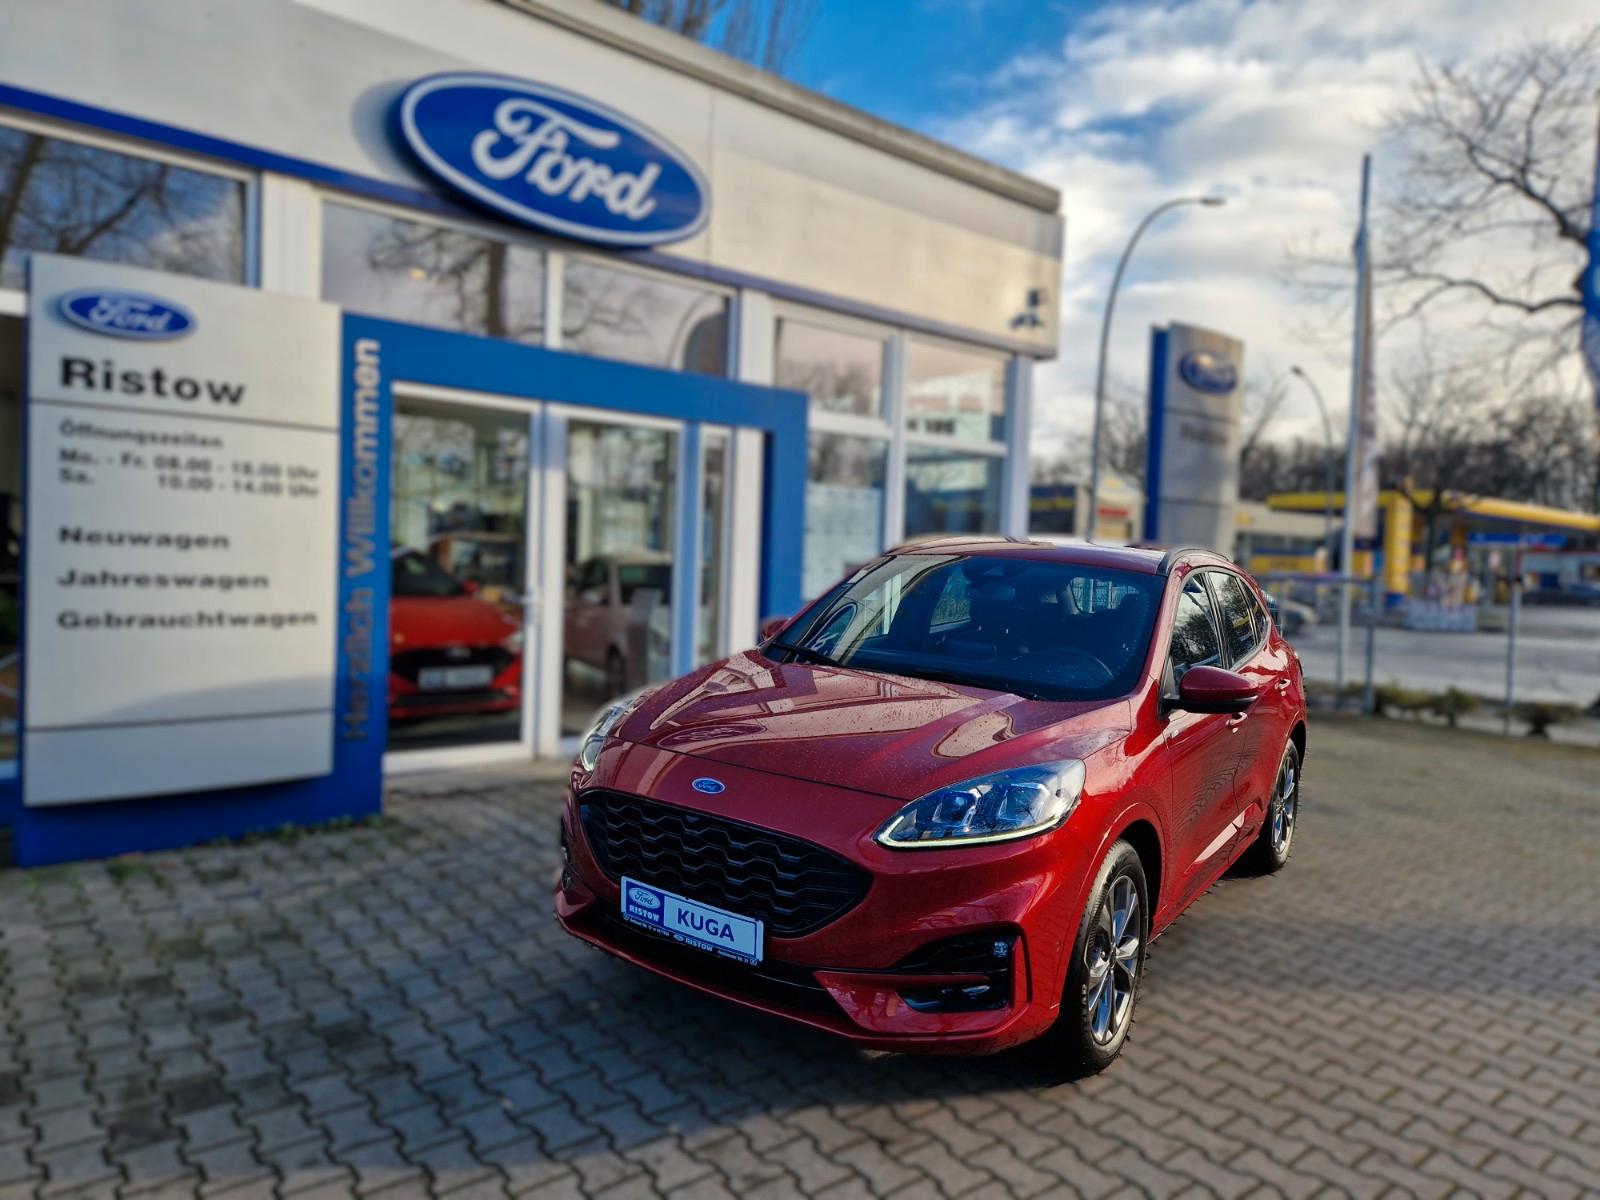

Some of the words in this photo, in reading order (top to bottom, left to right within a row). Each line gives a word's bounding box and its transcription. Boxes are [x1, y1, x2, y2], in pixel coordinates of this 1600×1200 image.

[471, 98, 662, 221] Ford
[88, 296, 175, 333] Ford
[60, 355, 246, 406] Ristow
[59, 418, 223, 448] Öffnungszeiten
[346, 337, 380, 579] Willkommen
[286, 464, 320, 480] Uhr
[286, 481, 321, 498] Uhr
[58, 525, 230, 552] Neuwagen
[57, 567, 270, 592] Jahreswagen
[56, 608, 319, 630] Gebrauchtwagen
[634, 890, 654, 906] Ford
[628, 904, 660, 922] RISTOW
[677, 907, 735, 942] KUGA
